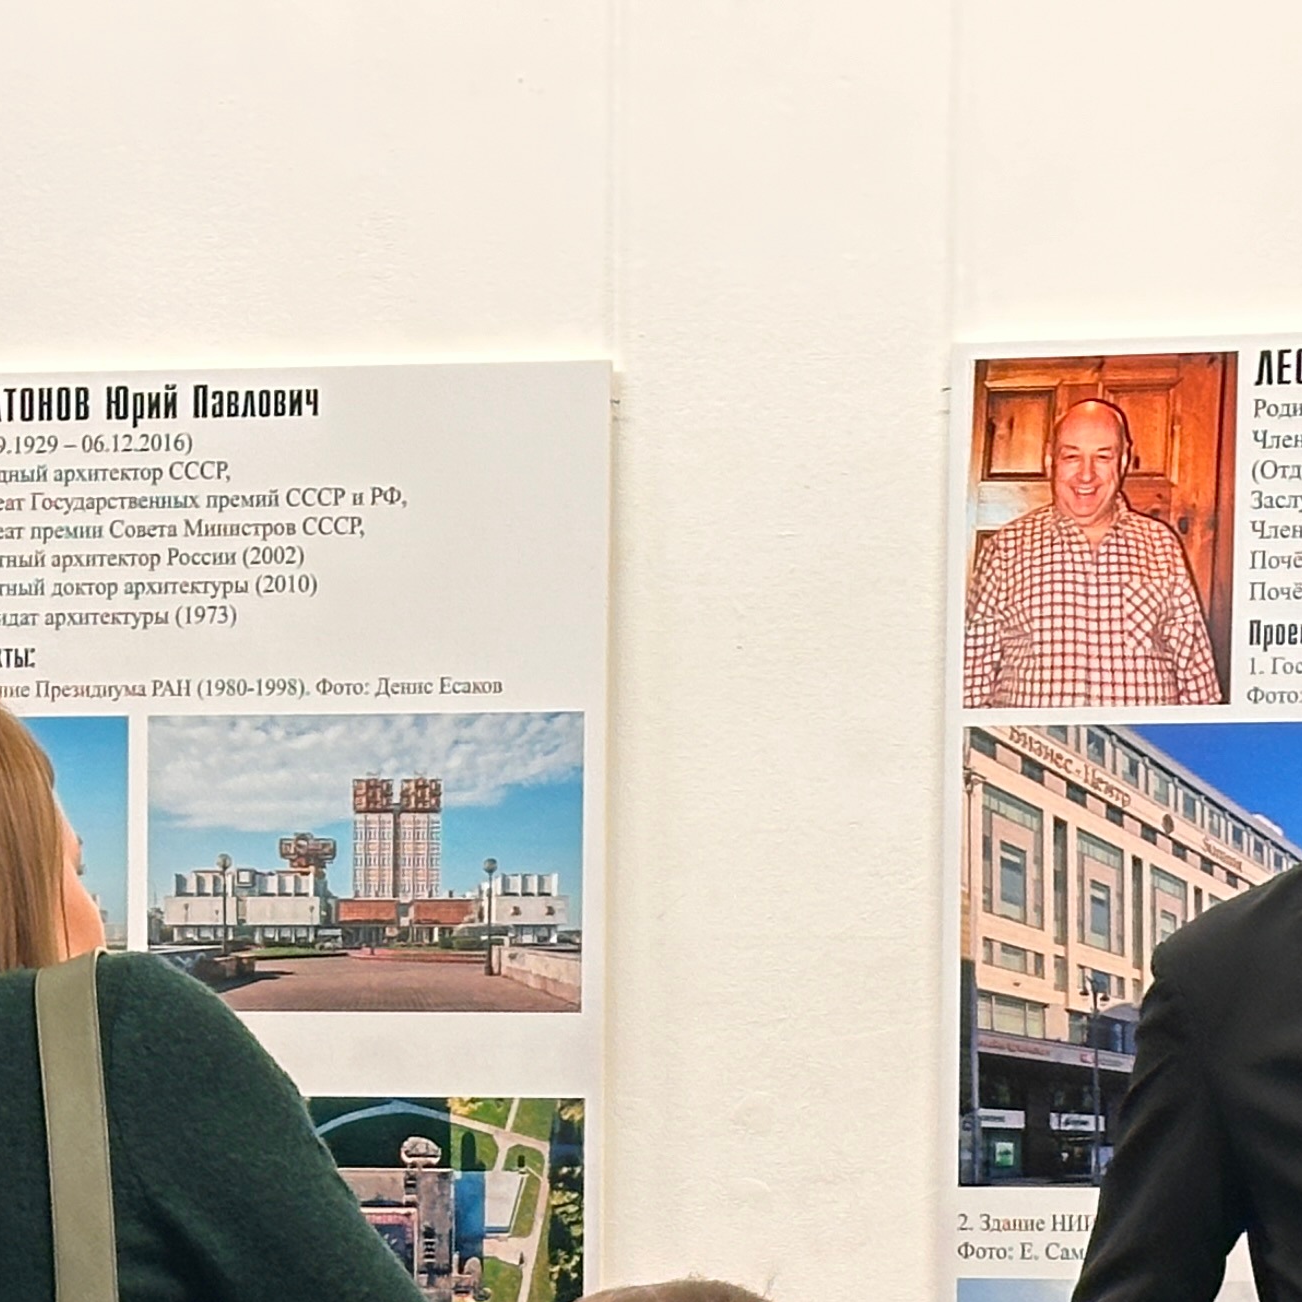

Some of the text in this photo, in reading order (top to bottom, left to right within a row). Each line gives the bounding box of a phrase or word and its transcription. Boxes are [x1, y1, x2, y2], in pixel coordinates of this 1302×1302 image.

[106, 383, 178, 430] Юрий
[192, 383, 319, 420] Павлович
[81, 432, 193, 457] 06.12.2016)
[53, 465, 164, 489] архитектор
[168, 459, 231, 484] СССР,
[30, 491, 201, 517] Государственных
[205, 488, 280, 514] премий
[285, 486, 346, 508] СССР
[352, 491, 364, 507] и
[370, 485, 407, 508] РФ,
[30, 524, 104, 546] премии
[108, 518, 178, 540] Совета
[183, 518, 297, 543] Министров
[302, 515, 365, 539] СССР,
[50, 552, 162, 575] архитектор
[166, 547, 237, 568] России
[242, 545, 305, 570] (2002)
[50, 580, 119, 602] доктор
[123, 579, 249, 602] архитектуры
[255, 573, 318, 598] (2010)
[44, 609, 169, 632] архитектуры
[174, 603, 237, 629] (1973)
[1249, 656, 1265, 675] 1.
[35, 679, 147, 703] Президиума
[151, 678, 192, 698] РАН
[196, 677, 313, 701] (1980-1998).
[315, 677, 370, 697] Фото:
[373, 676, 434, 699] Денис
[438, 675, 503, 696] Есаков
[956, 1212, 974, 1233] 2.
[979, 1212, 1046, 1234] Здание
[957, 1241, 1014, 1260] Фото:
[1019, 1241, 1039, 1261] Е.
